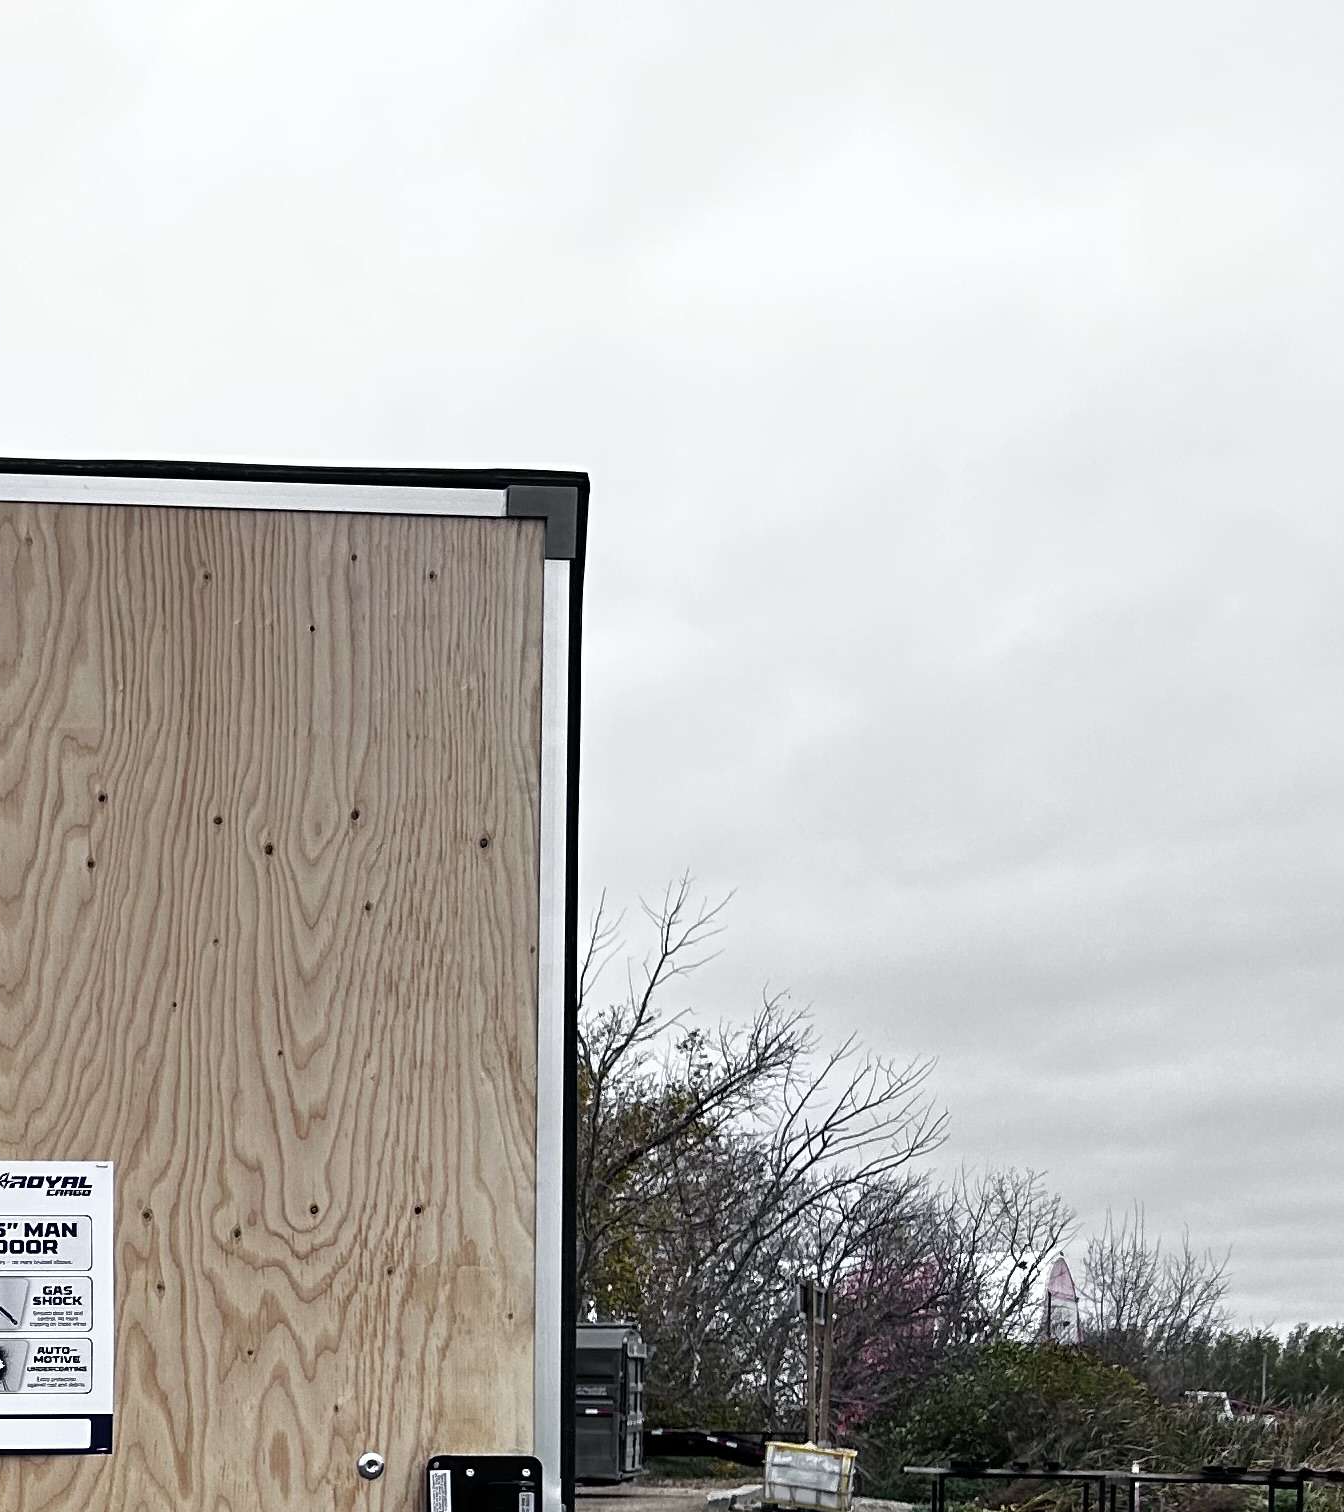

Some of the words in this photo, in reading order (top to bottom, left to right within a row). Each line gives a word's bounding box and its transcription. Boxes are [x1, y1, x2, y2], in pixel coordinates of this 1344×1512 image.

[8, 1175, 93, 1189] ROYAL
[45, 1189, 92, 1197] CARGO
[24, 1222, 78, 1238] MAN
[42, 1285, 73, 1296] GAS
[32, 1296, 83, 1306] SHOCK
[36, 1346, 78, 1355] AUTO-
[33, 1355, 81, 1364] MOTIVE
